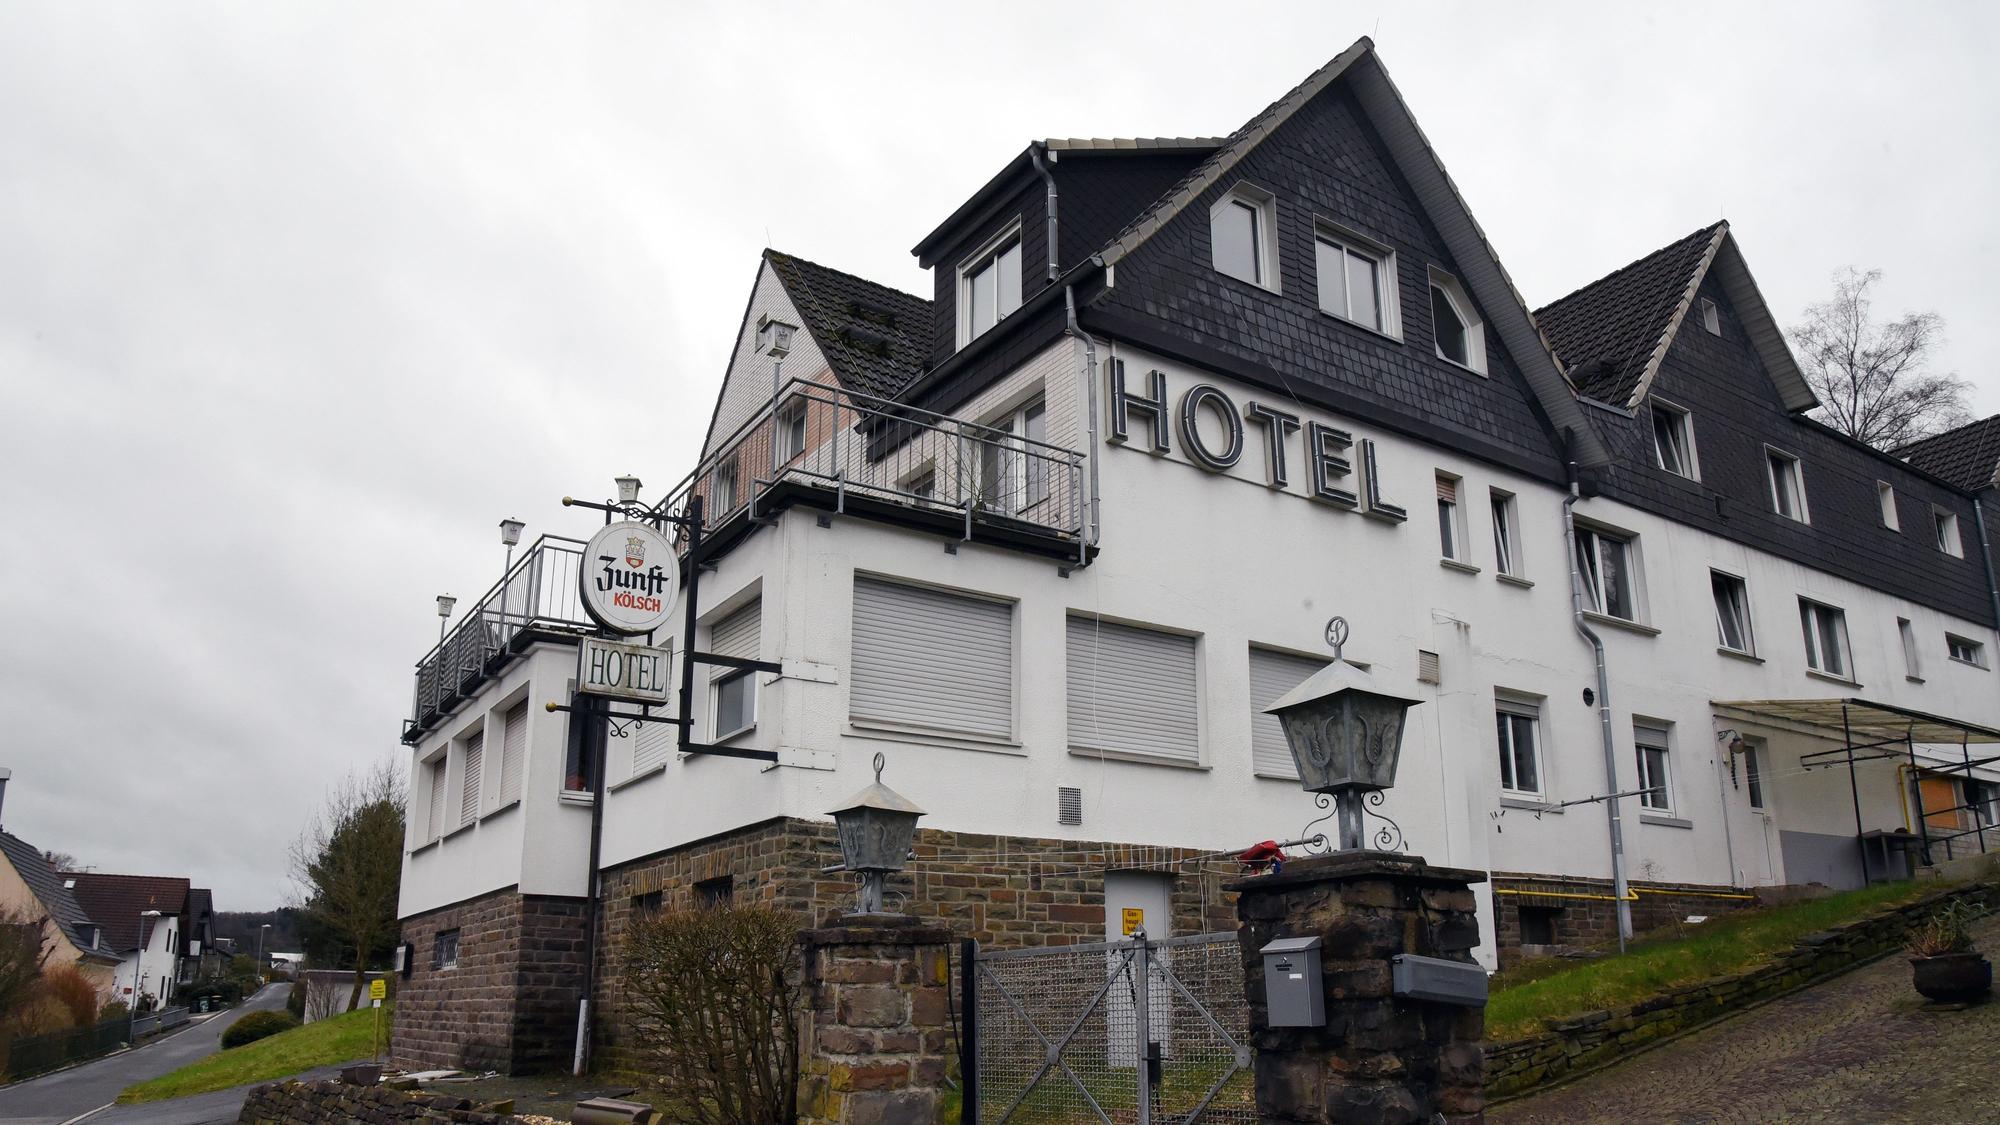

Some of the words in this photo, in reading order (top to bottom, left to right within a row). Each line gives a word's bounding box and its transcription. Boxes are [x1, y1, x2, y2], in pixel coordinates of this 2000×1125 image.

[1104, 356, 1407, 525] HOTEL
[614, 590, 661, 613] KÖLSCH
[588, 647, 665, 692] HOTEL
